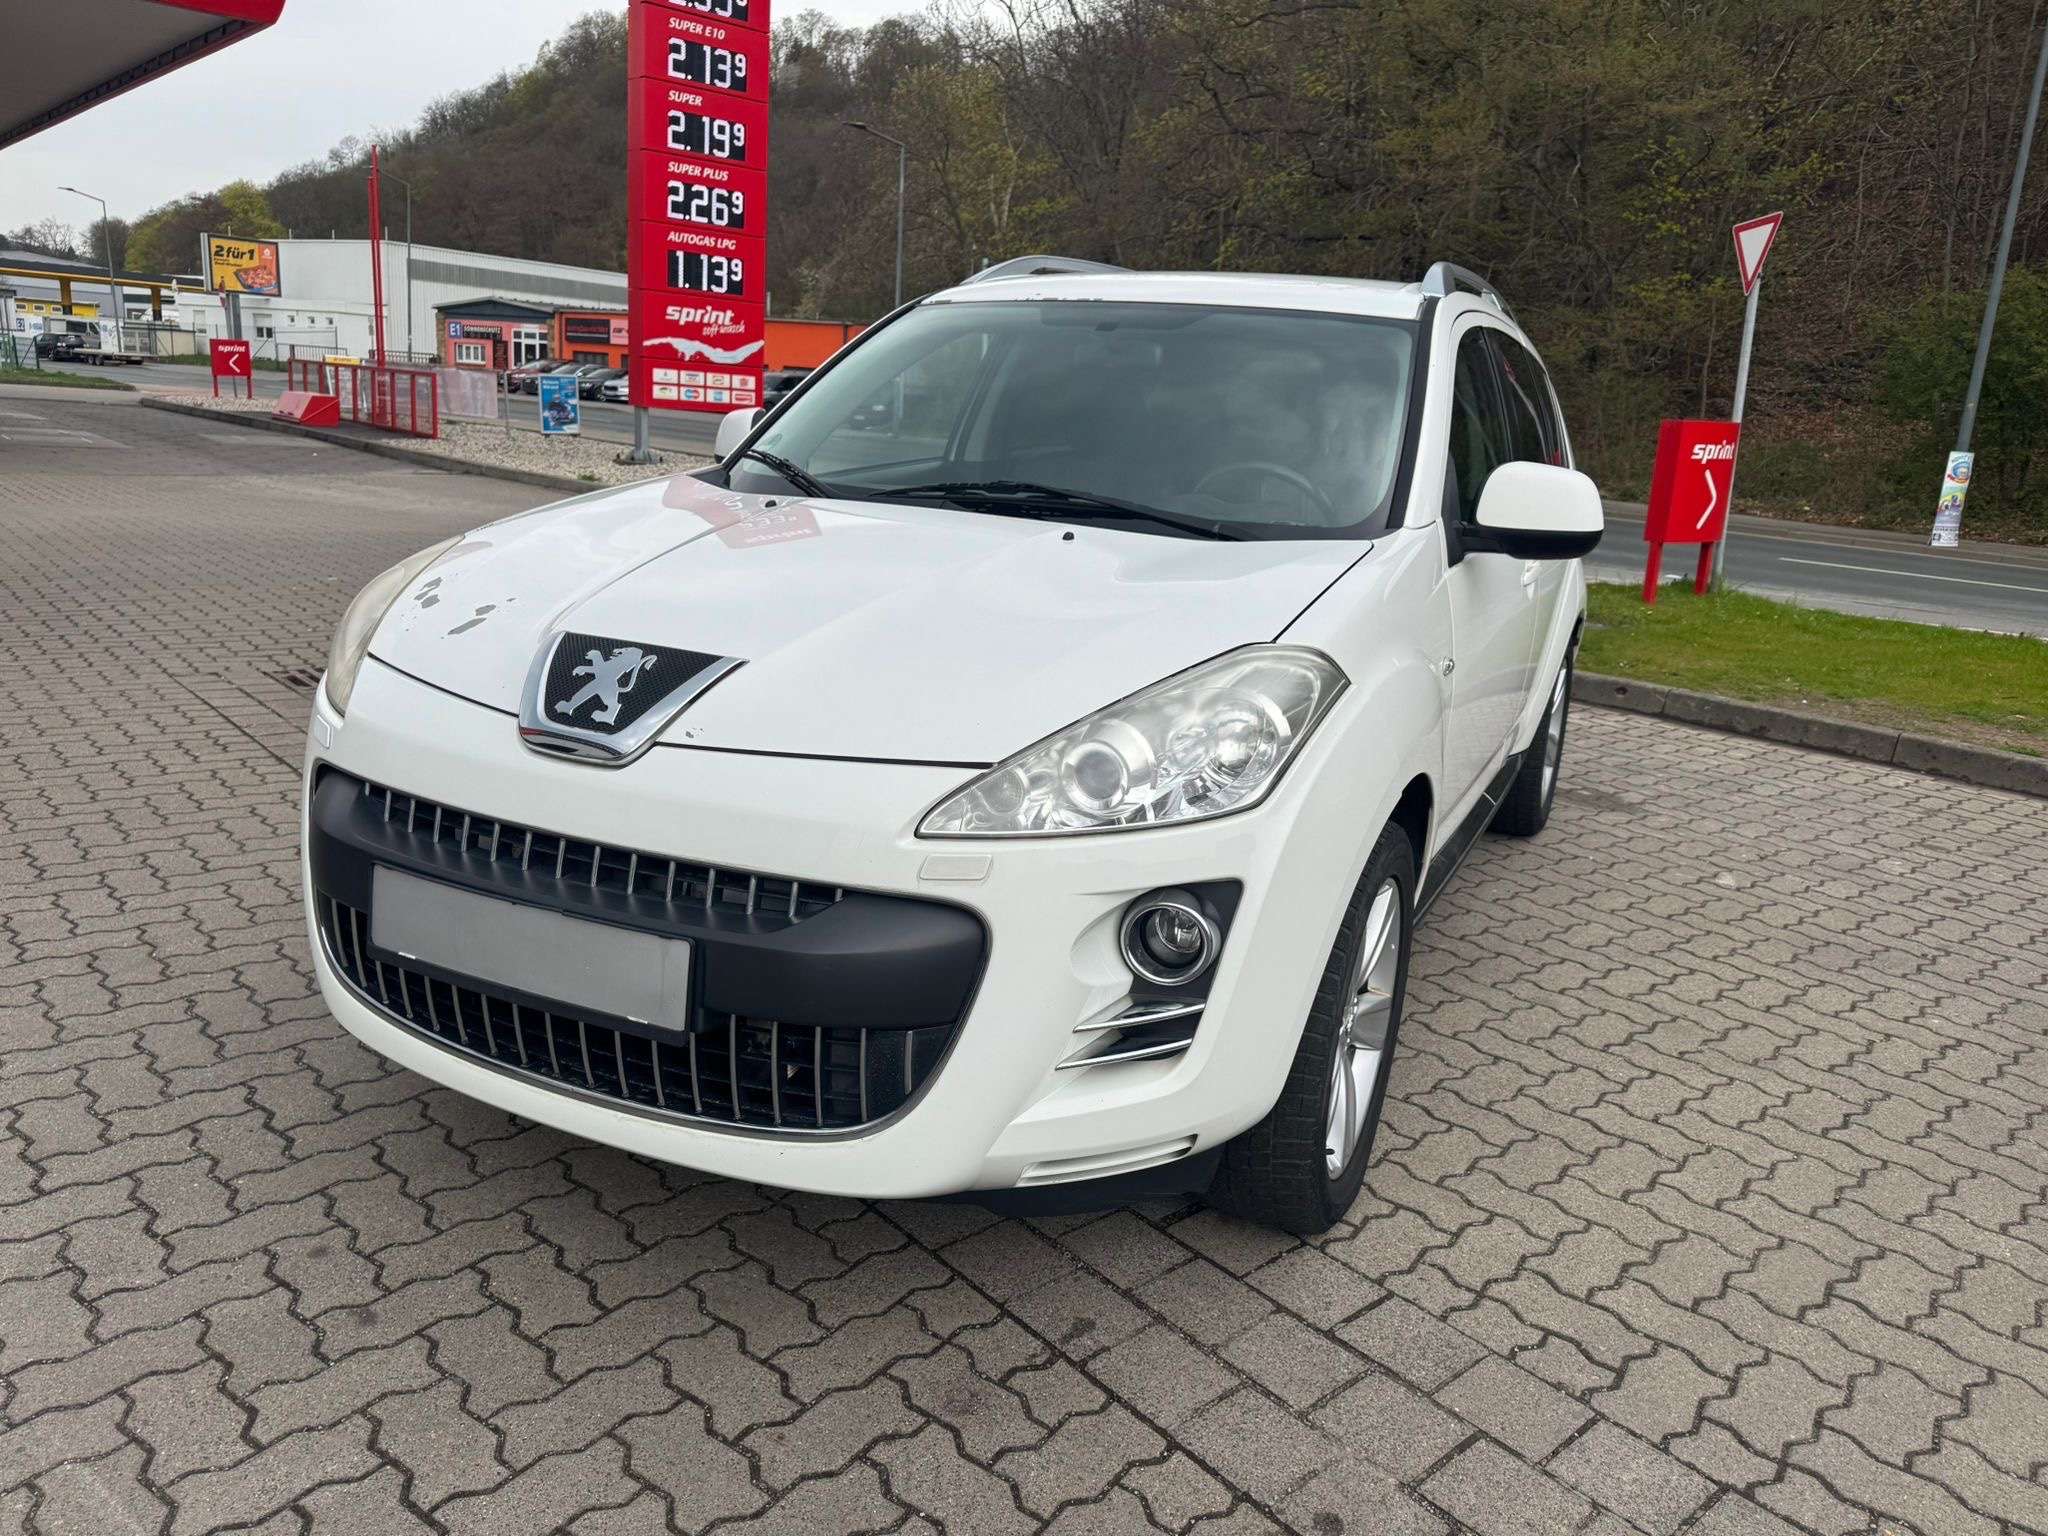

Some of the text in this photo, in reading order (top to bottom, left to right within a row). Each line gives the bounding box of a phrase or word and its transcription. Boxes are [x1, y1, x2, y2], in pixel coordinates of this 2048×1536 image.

[668, 17, 726, 40] SUPER E10
[668, 90, 703, 107] SUPER
[667, 161, 730, 181] SUPER PLUS
[667, 230, 736, 250] AUTOGAS LPG
[214, 245, 224, 257] 2
[225, 246, 247, 260] für
[247, 249, 255, 260] 1
[665, 304, 735, 326] sprint
[449, 323, 461, 336] E1
[218, 344, 246, 353] sprint
[1690, 440, 1735, 465] sprint
